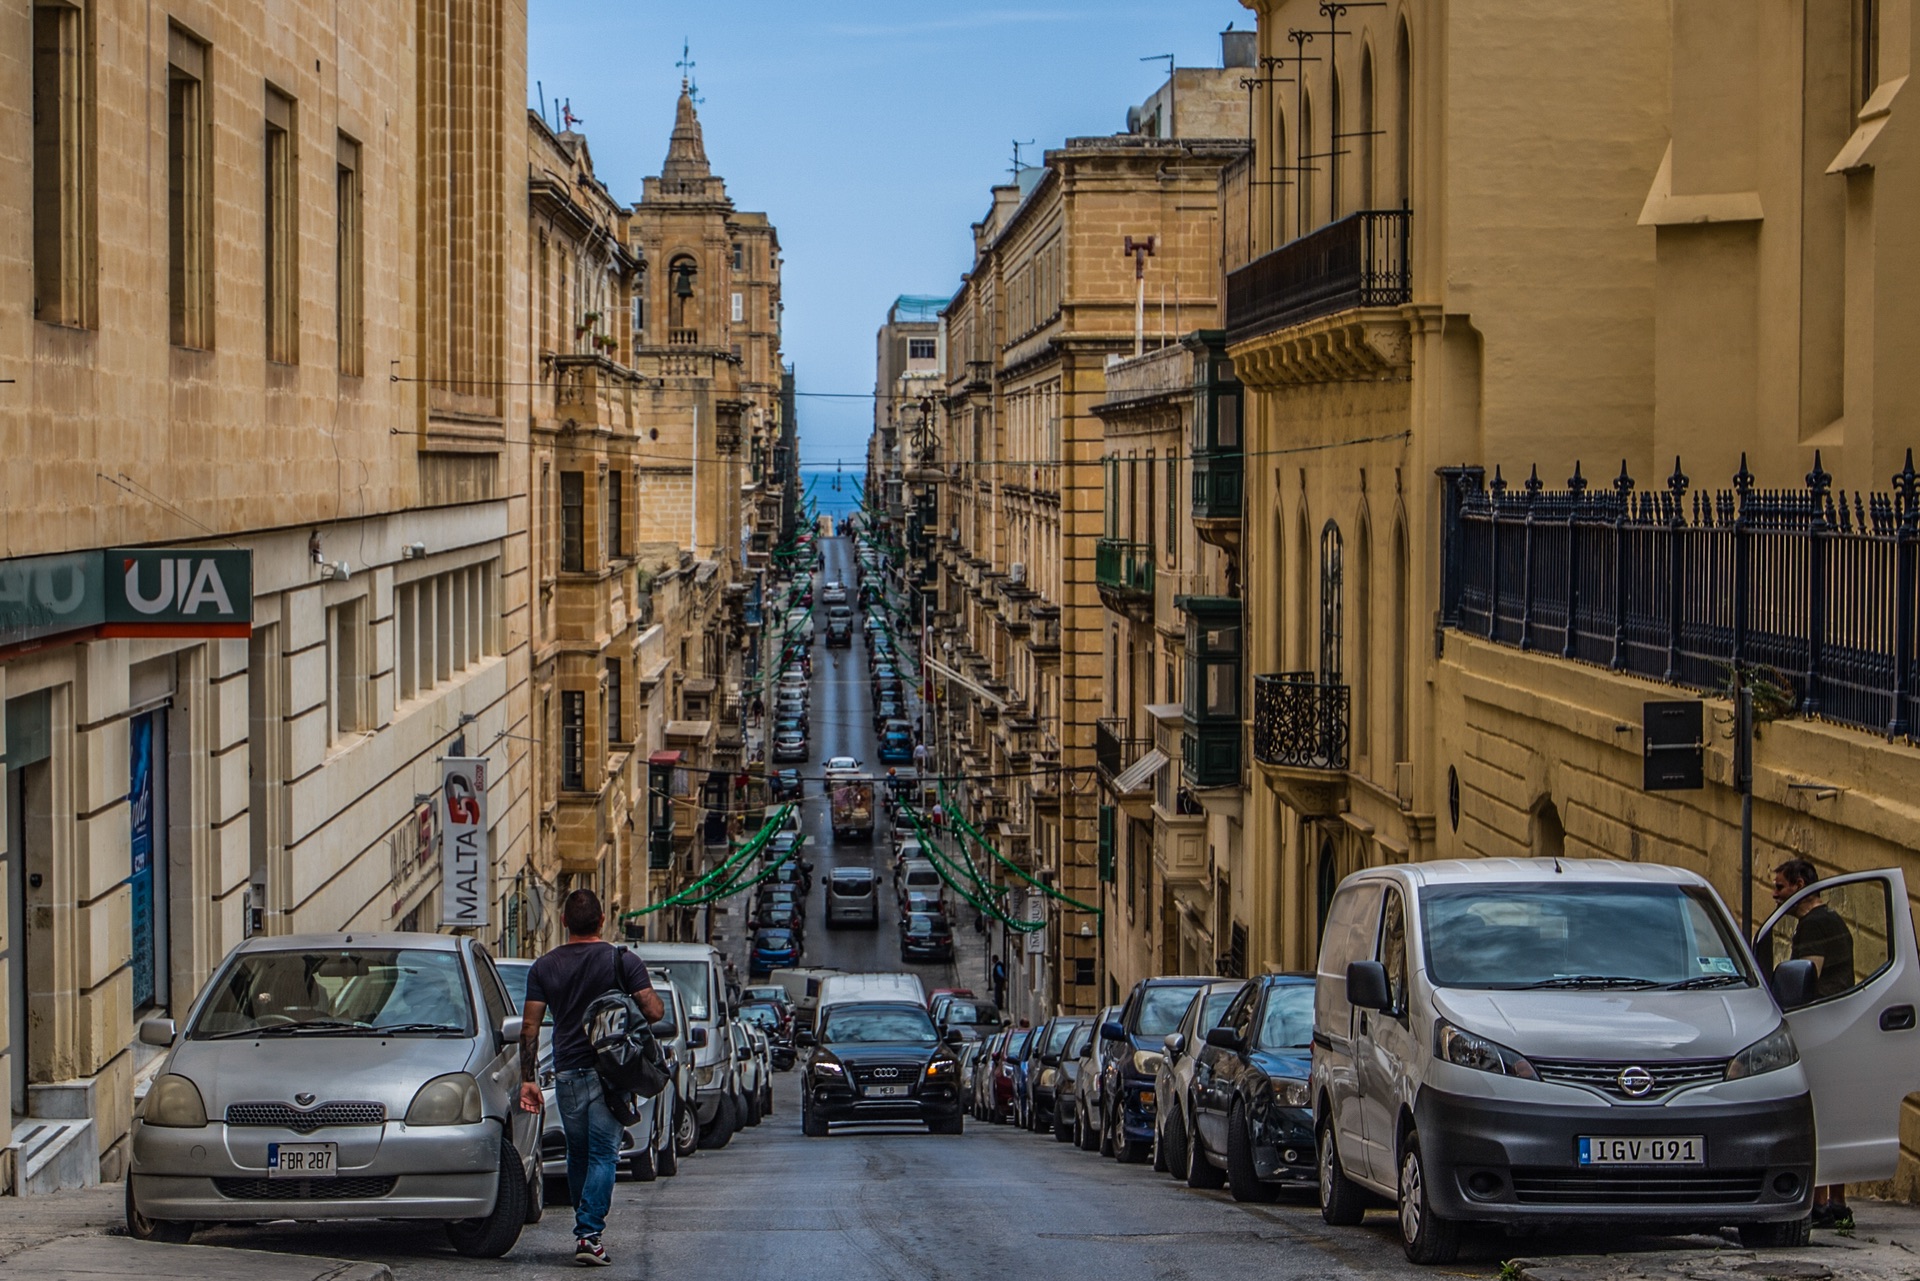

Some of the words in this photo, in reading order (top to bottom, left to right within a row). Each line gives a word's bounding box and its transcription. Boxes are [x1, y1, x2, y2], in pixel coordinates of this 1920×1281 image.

[124, 559, 234, 614] UIA
[444, 771, 480, 826] 5D
[474, 764, 484, 792] show
[456, 829, 478, 919] MALTA
[280, 1152, 303, 1170] FBR
[308, 1151, 332, 1169] 287
